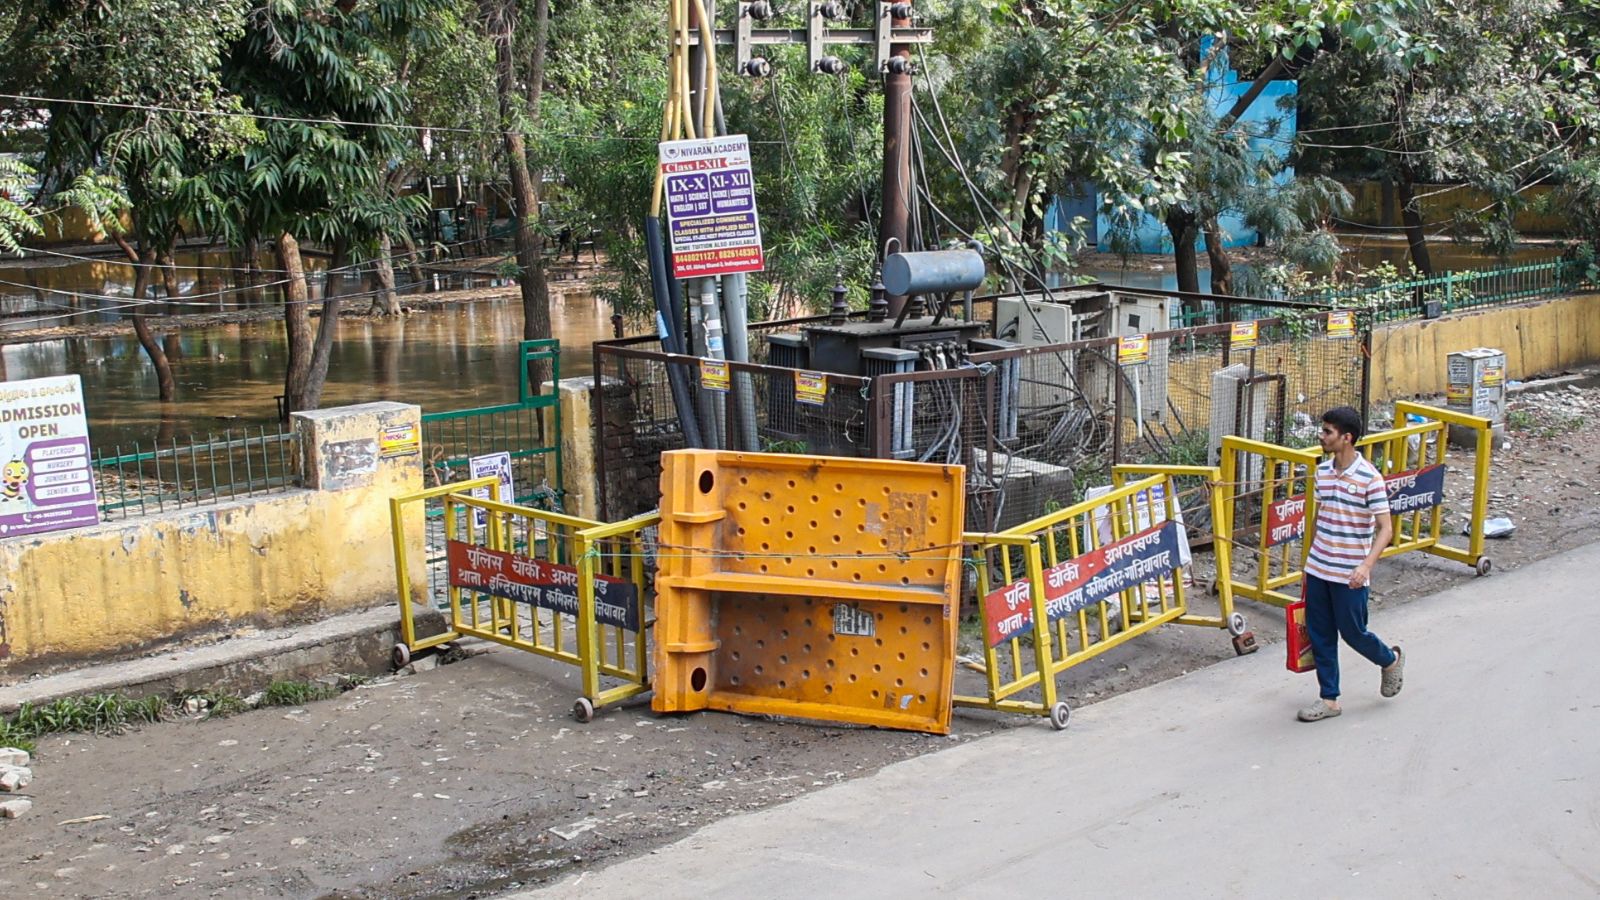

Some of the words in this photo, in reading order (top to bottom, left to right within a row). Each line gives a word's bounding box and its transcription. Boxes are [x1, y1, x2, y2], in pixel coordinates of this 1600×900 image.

[681, 145, 712, 158] NIVARAN
[714, 142, 748, 154] ACADEMY
[666, 163, 694, 173] Class
[696, 158, 722, 170] I-XII
[671, 177, 706, 193] IX-X
[700, 226, 714, 234] WITH
[738, 220, 755, 230] MATH
[716, 215, 747, 224] COMMERCE
[692, 242, 713, 250] TUITION
[729, 238, 757, 246] AVAILABLE
[0, 402, 82, 423] DMISSION
[18, 423, 59, 439] OPEN
[467, 547, 505, 571] पुलिस
[1004, 581, 1031, 611] पुलि
[1048, 561, 1080, 589] चौकी
